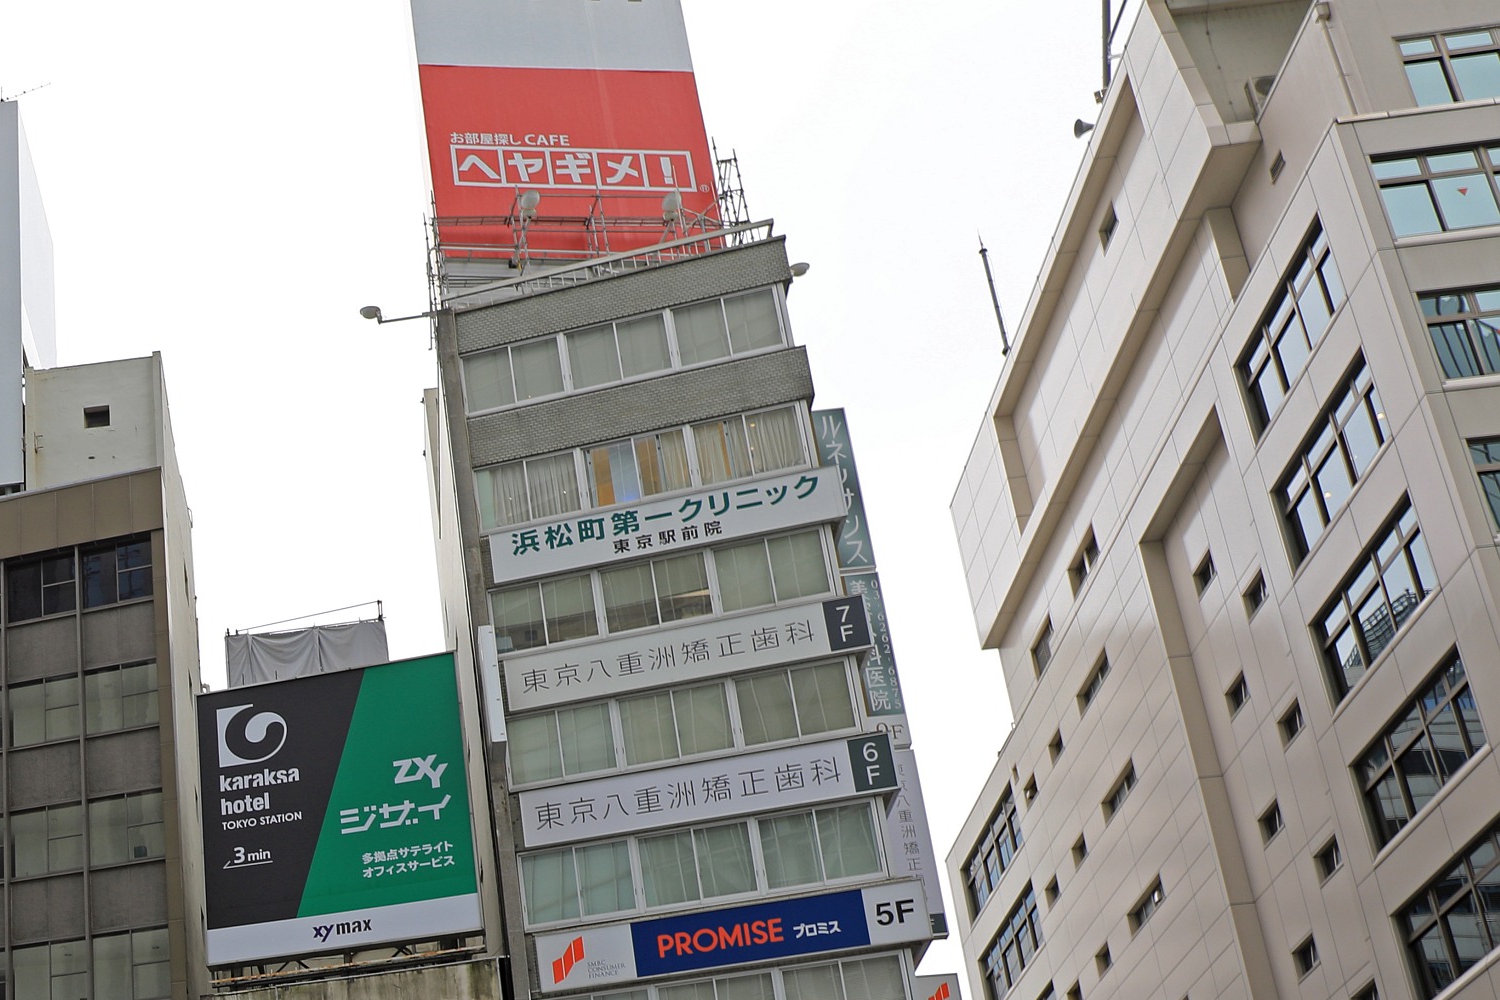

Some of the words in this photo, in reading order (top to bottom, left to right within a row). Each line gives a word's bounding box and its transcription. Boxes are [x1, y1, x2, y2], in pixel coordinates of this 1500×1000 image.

[450, 131, 521, 146] お部屋探し
[524, 133, 570, 146] CAFE
[511, 475, 820, 556] 浜松町第一クリニック
[612, 520, 723, 554] 東京駅前院
[835, 605, 855, 642] 7F
[521, 619, 816, 694] 東京八重洲矯正歯科
[862, 741, 881, 786] 6F
[219, 767, 300, 793] karaksa
[221, 792, 270, 816] hotel
[536, 756, 842, 831] 東京八重洲矯正歯科
[222, 818, 258, 831] TOKYO
[259, 811, 303, 826] STATION
[340, 794, 451, 834] ジザイ
[233, 847, 245, 864] 3
[247, 849, 271, 862] min
[361, 841, 454, 865] 多拠点サテライト
[362, 855, 455, 879] オフィスサービス
[875, 900, 916, 927] 5F
[312, 919, 372, 942] xymax
[657, 918, 785, 959] PROMISE
[793, 920, 842, 939] プロミス
[587, 963, 626, 973] CONSUMER
[588, 970, 619, 979] FINANCE
